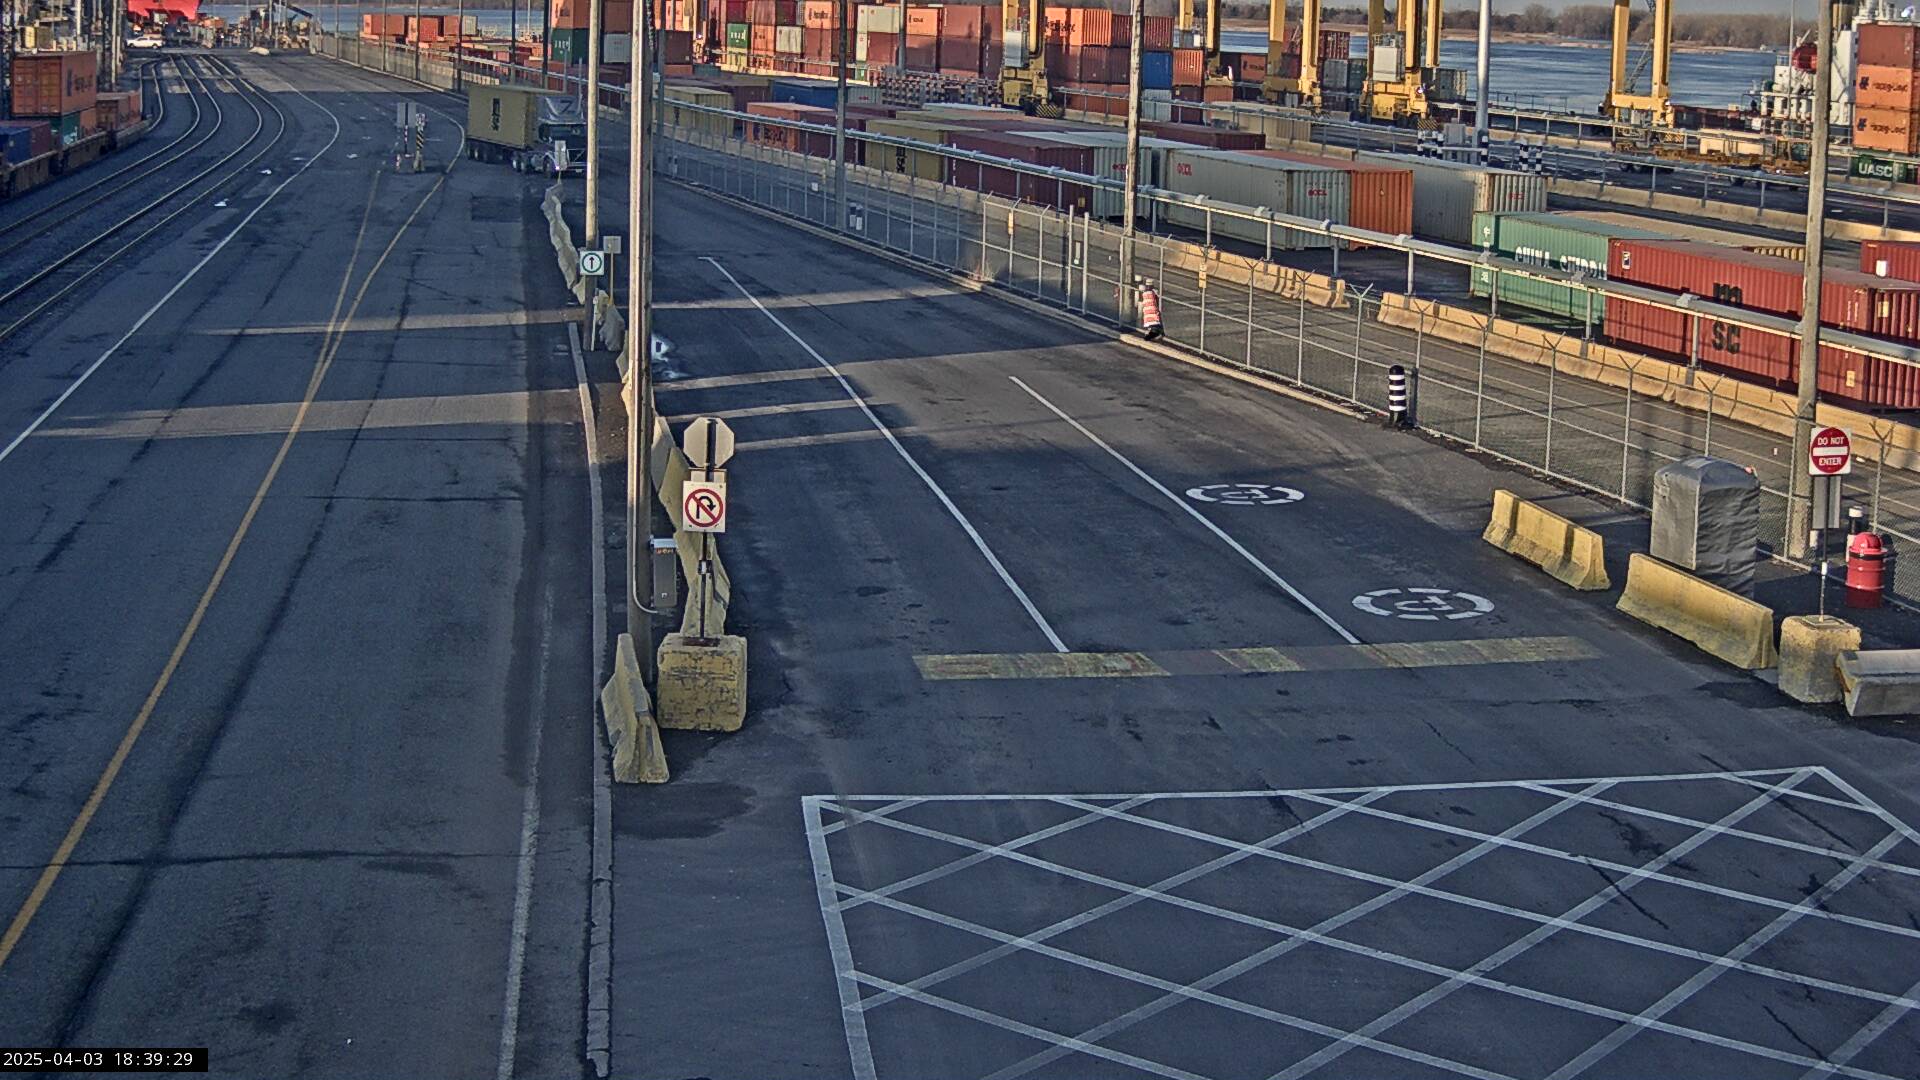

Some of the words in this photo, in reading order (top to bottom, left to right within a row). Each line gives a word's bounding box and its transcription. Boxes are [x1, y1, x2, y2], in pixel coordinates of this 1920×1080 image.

[1859, 162, 1893, 178] UASC
[1818, 437, 1828, 445] DO
[1831, 437, 1844, 445] NOT
[1819, 457, 1841, 466] ENTER
